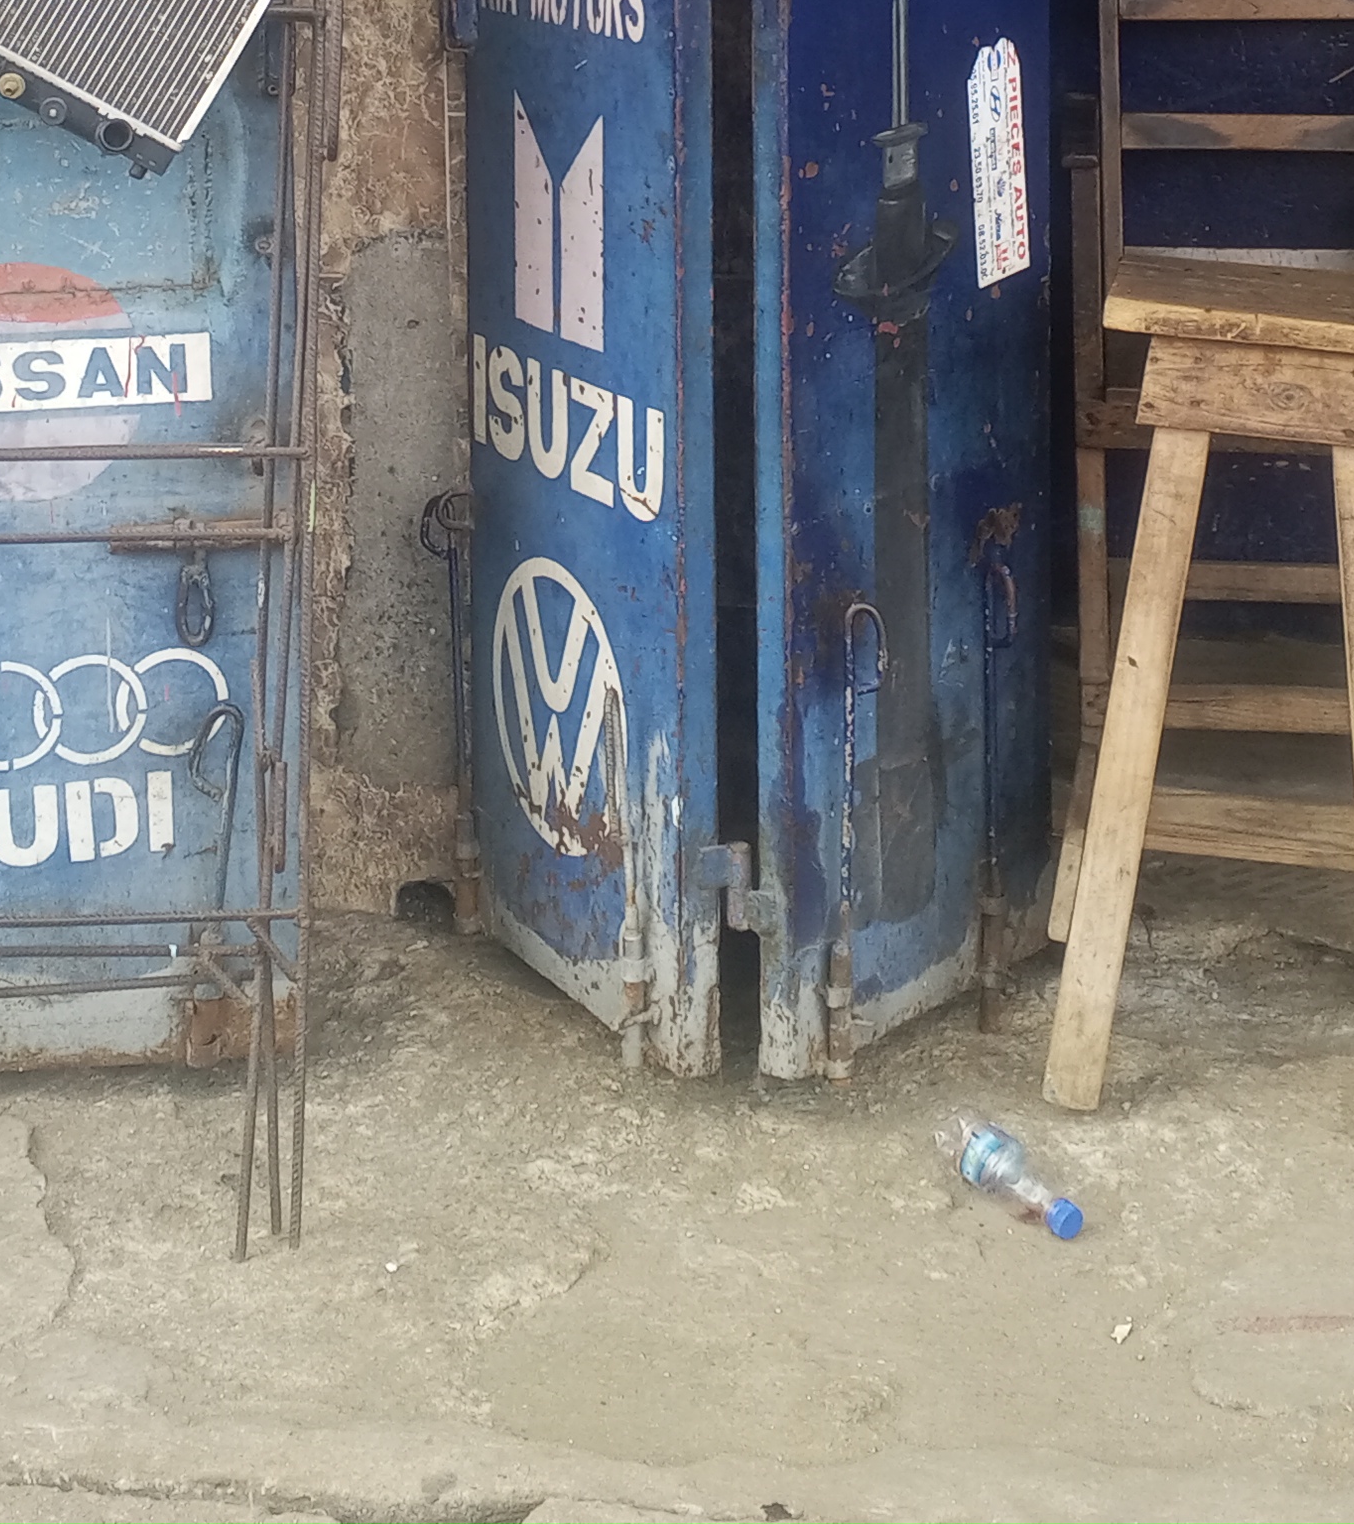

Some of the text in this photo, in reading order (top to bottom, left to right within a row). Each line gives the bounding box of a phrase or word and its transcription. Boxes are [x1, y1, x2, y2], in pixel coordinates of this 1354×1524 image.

[1008, 77, 1021, 176] PIECES
[1013, 186, 1026, 260] AUTO
[473, 332, 665, 522] ISUZU
